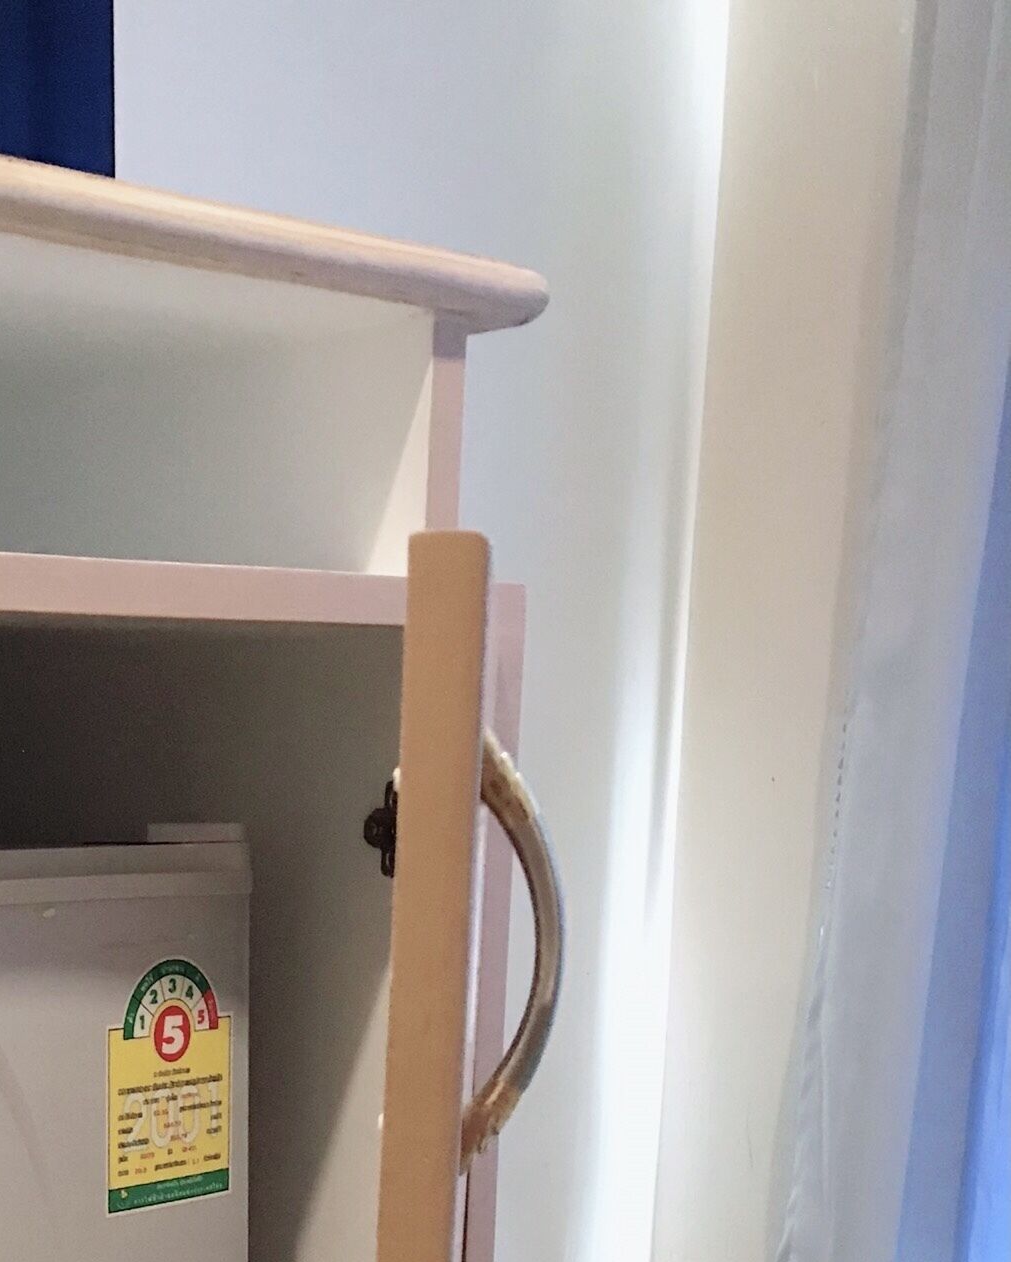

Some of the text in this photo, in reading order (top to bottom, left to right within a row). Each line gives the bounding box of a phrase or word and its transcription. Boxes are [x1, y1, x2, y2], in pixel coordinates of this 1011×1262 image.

[139, 1014, 145, 1030] 1
[149, 989, 158, 1004] 2
[168, 978, 176, 993] 3
[185, 985, 194, 1000] 4
[197, 1009, 205, 1025] 5
[161, 1014, 185, 1055] 5
[123, 1081, 219, 1153] 2001
